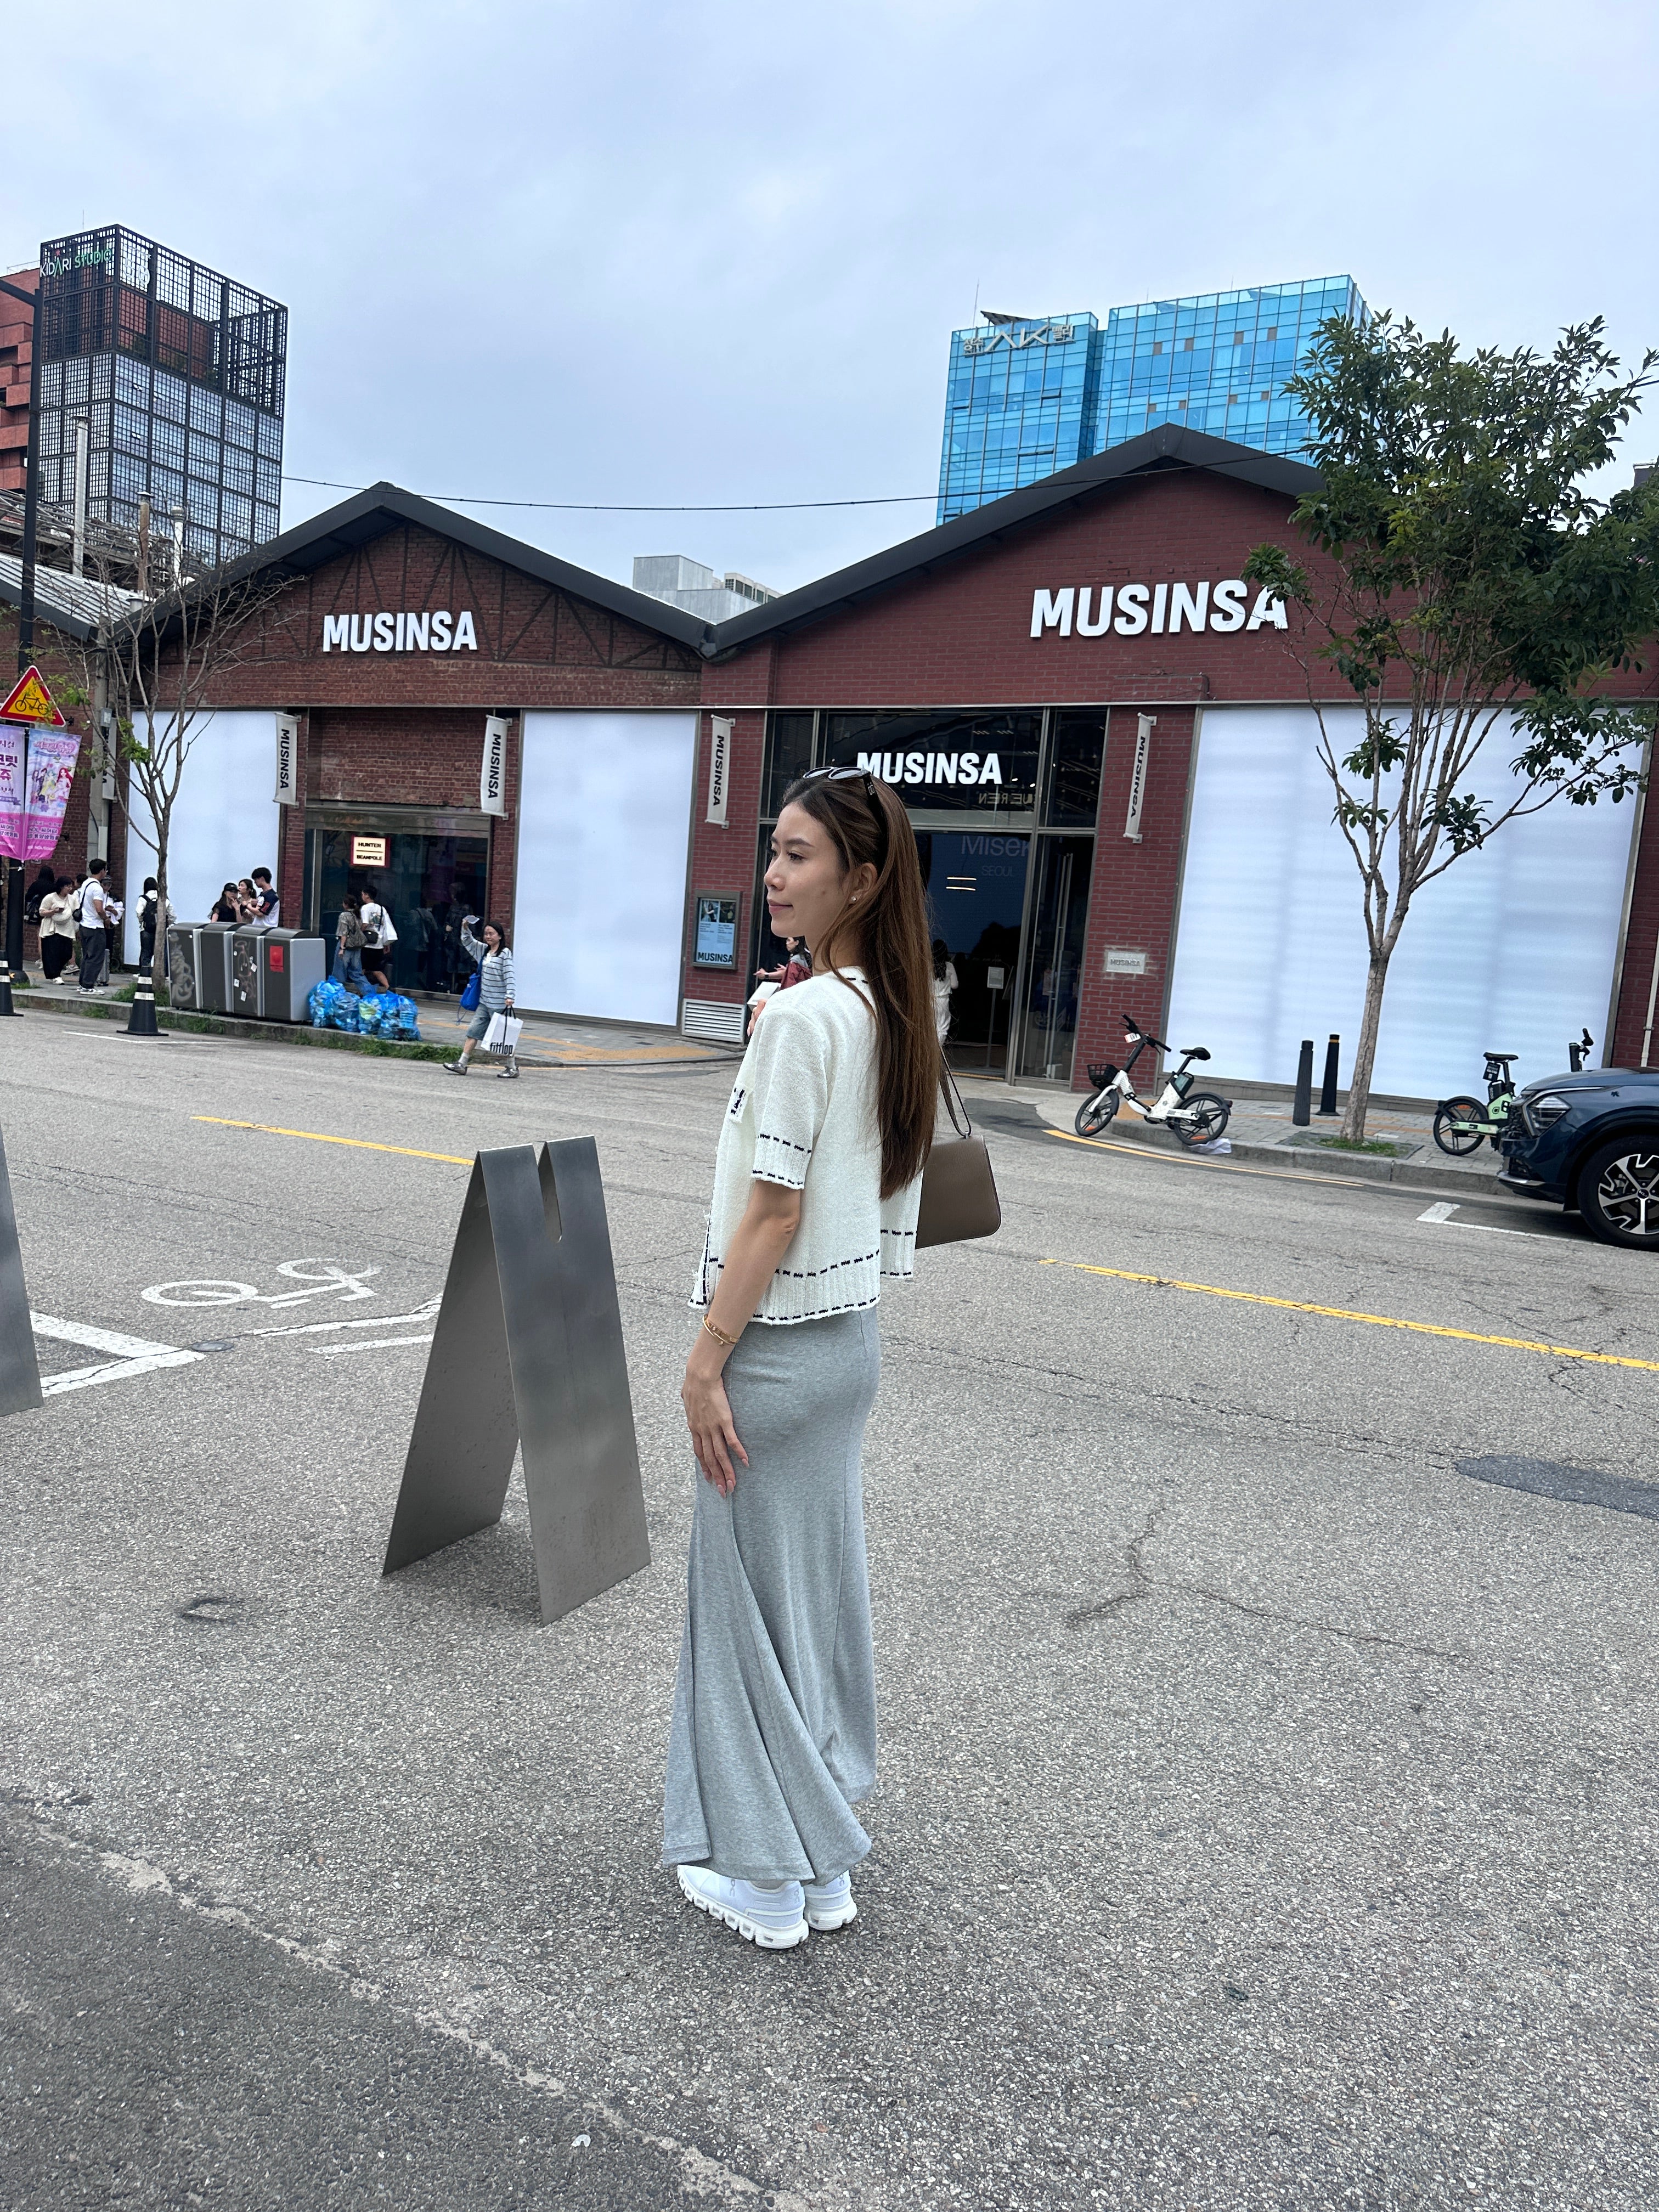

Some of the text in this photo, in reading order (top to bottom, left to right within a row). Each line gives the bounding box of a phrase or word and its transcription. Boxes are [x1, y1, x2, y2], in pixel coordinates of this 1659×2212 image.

[40, 257, 72, 277] KIDARI
[74, 249, 112, 269] STUDIO
[323, 611, 478, 652] MUSINSA
[1030, 579, 1288, 638] MUSINSA
[280, 729, 290, 789] MUSINSA
[488, 733, 501, 798] MUSINSA
[713, 735, 724, 806] MUSINSA
[856, 752, 1002, 785] MUSINSA
[1131, 736, 1146, 817] MUSINSA
[698, 952, 732, 963] MUSINSA
[1110, 958, 1141, 967] MUSINSA
